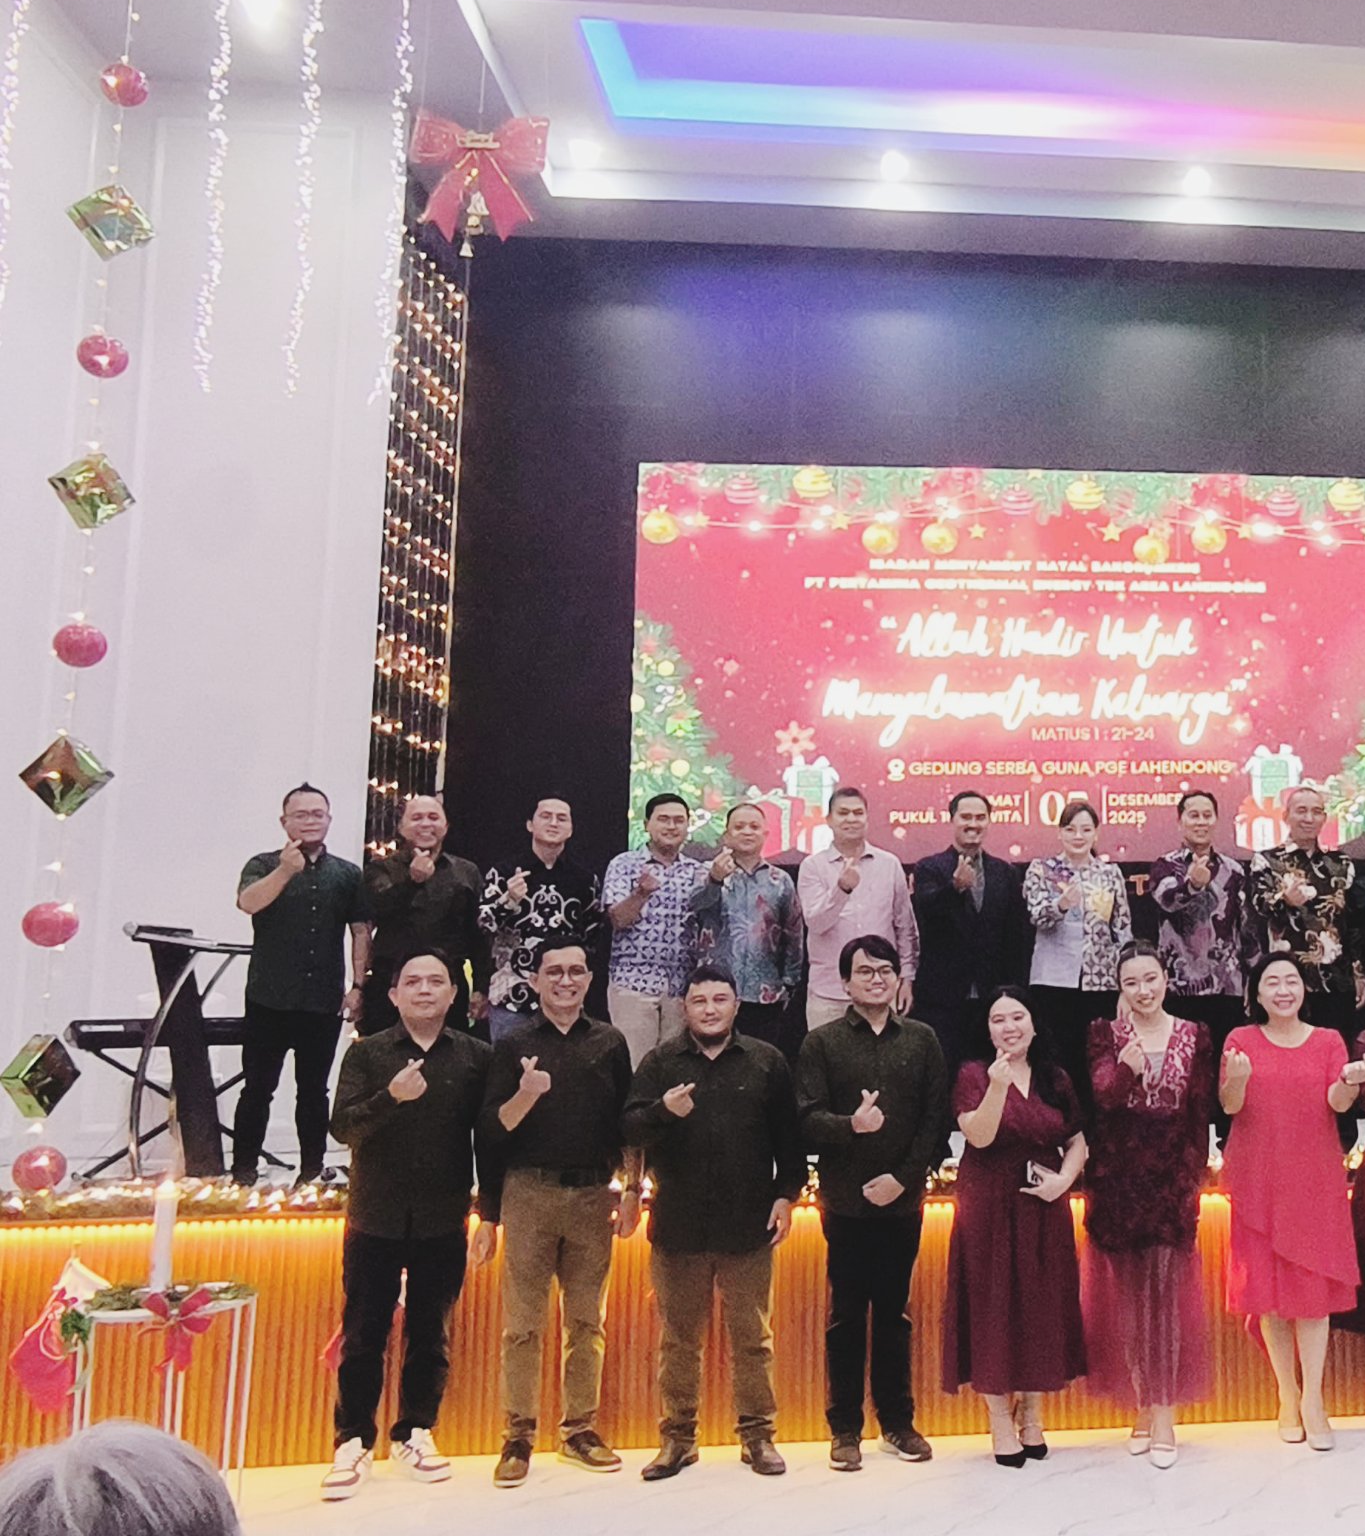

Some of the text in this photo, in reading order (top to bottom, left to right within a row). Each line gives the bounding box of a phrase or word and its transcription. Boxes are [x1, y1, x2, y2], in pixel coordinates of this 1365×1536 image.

[1030, 726, 1091, 741] MATIUS
[1111, 726, 1155, 741] 21-24
[908, 761, 982, 776] GEDUNG
[985, 761, 1037, 775] SERBA
[1042, 761, 1090, 775] GUNA
[1095, 760, 1128, 775] PGE
[985, 794, 1022, 807] MAT
[889, 810, 938, 824] PUKUL
[1108, 810, 1148, 825] 2025
